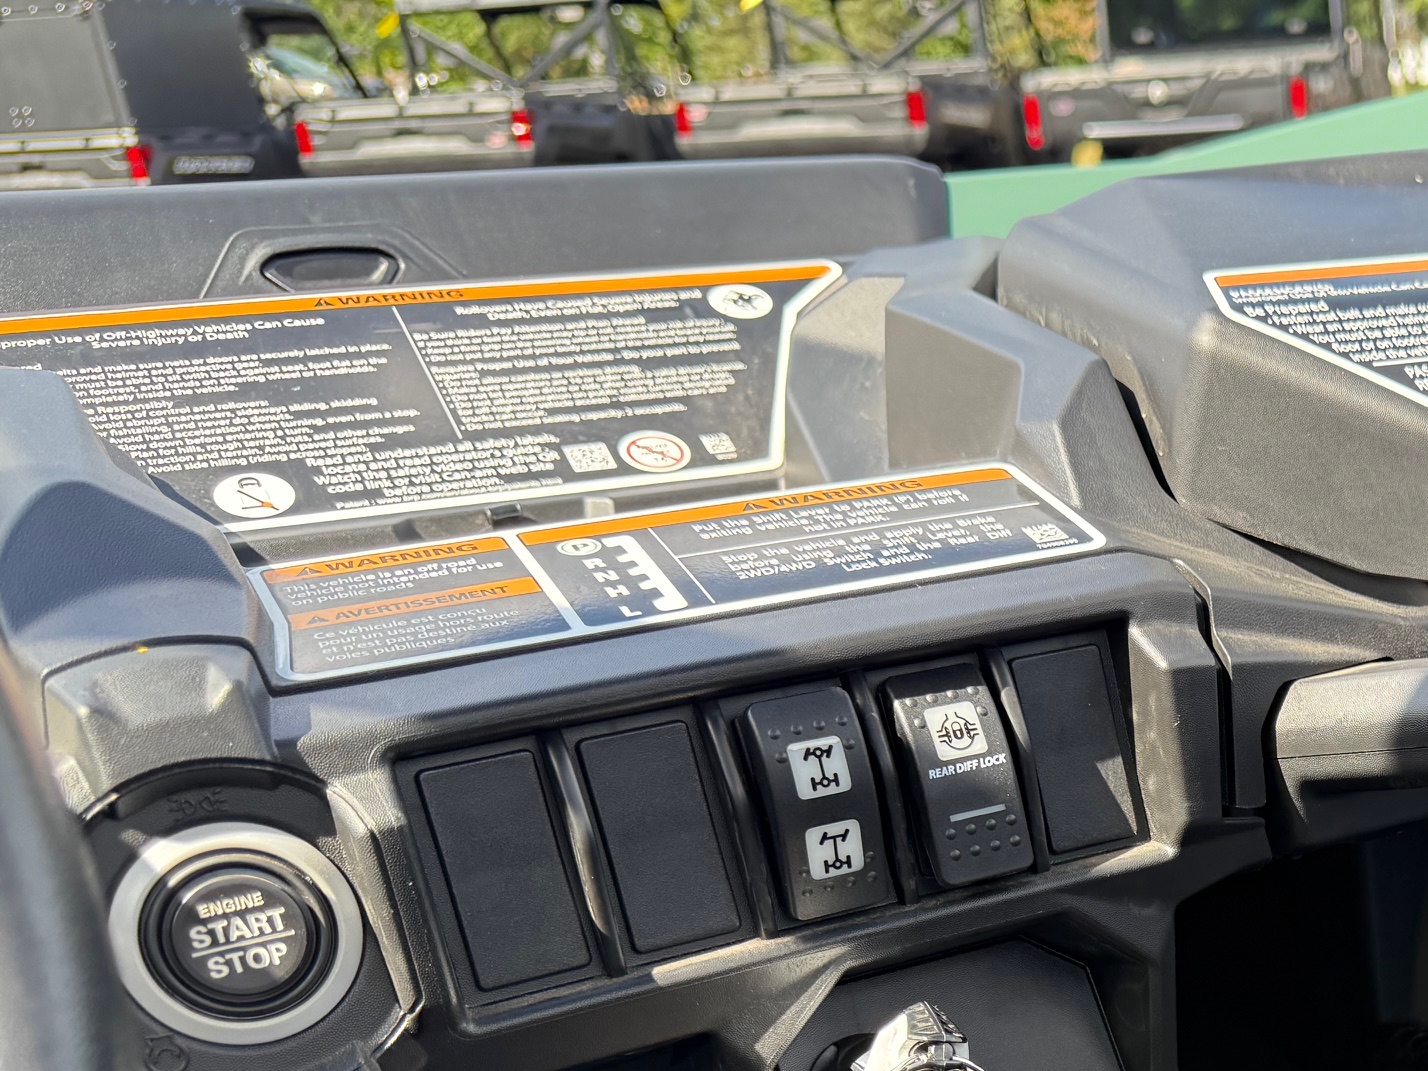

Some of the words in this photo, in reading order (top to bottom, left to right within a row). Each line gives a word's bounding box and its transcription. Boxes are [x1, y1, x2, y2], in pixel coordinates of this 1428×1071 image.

[337, 290, 464, 305] WARNING
[53, 335, 84, 344] Use
[83, 332, 103, 341] of
[100, 326, 198, 342] Off-Highway
[193, 321, 254, 334] Vehicles
[251, 320, 283, 329] Can
[281, 316, 326, 327] Cause
[89, 338, 142, 348] Severe
[142, 335, 188, 346] Injury
[186, 334, 206, 342] or
[204, 330, 250, 340] Death
[771, 481, 923, 506] WARNING
[326, 544, 477, 570] WARNING
[572, 543, 589, 551] P
[286, 583, 314, 592] This
[320, 574, 375, 586] vehicle
[442, 558, 476, 568] road
[582, 558, 607, 569] R
[592, 570, 620, 583] N
[289, 586, 343, 598] vehicle
[349, 581, 373, 589] not
[379, 570, 448, 584] intended
[318, 589, 366, 602] public
[371, 582, 413, 593] roads
[604, 585, 630, 598] H
[335, 586, 510, 619] AVERTISSEMENT
[618, 606, 642, 617] L
[314, 631, 332, 639] Ce
[340, 619, 406, 635] véhicule
[439, 608, 486, 620] conçu
[319, 635, 356, 647] pour
[363, 631, 380, 639] un
[388, 623, 435, 636] usage
[439, 617, 472, 627] hors
[478, 610, 519, 621] route
[344, 640, 380, 650] n'est
[387, 635, 413, 644] pas
[418, 624, 475, 638] destiné
[481, 619, 508, 628] aux
[327, 649, 368, 661] voies
[374, 636, 454, 654] publiques
[929, 764, 955, 781] REAR
[956, 760, 979, 775] DIFF
[980, 753, 1007, 768] LOCK
[197, 891, 264, 919] ENGINE
[189, 906, 286, 950] START
[207, 942, 287, 979] STOP
